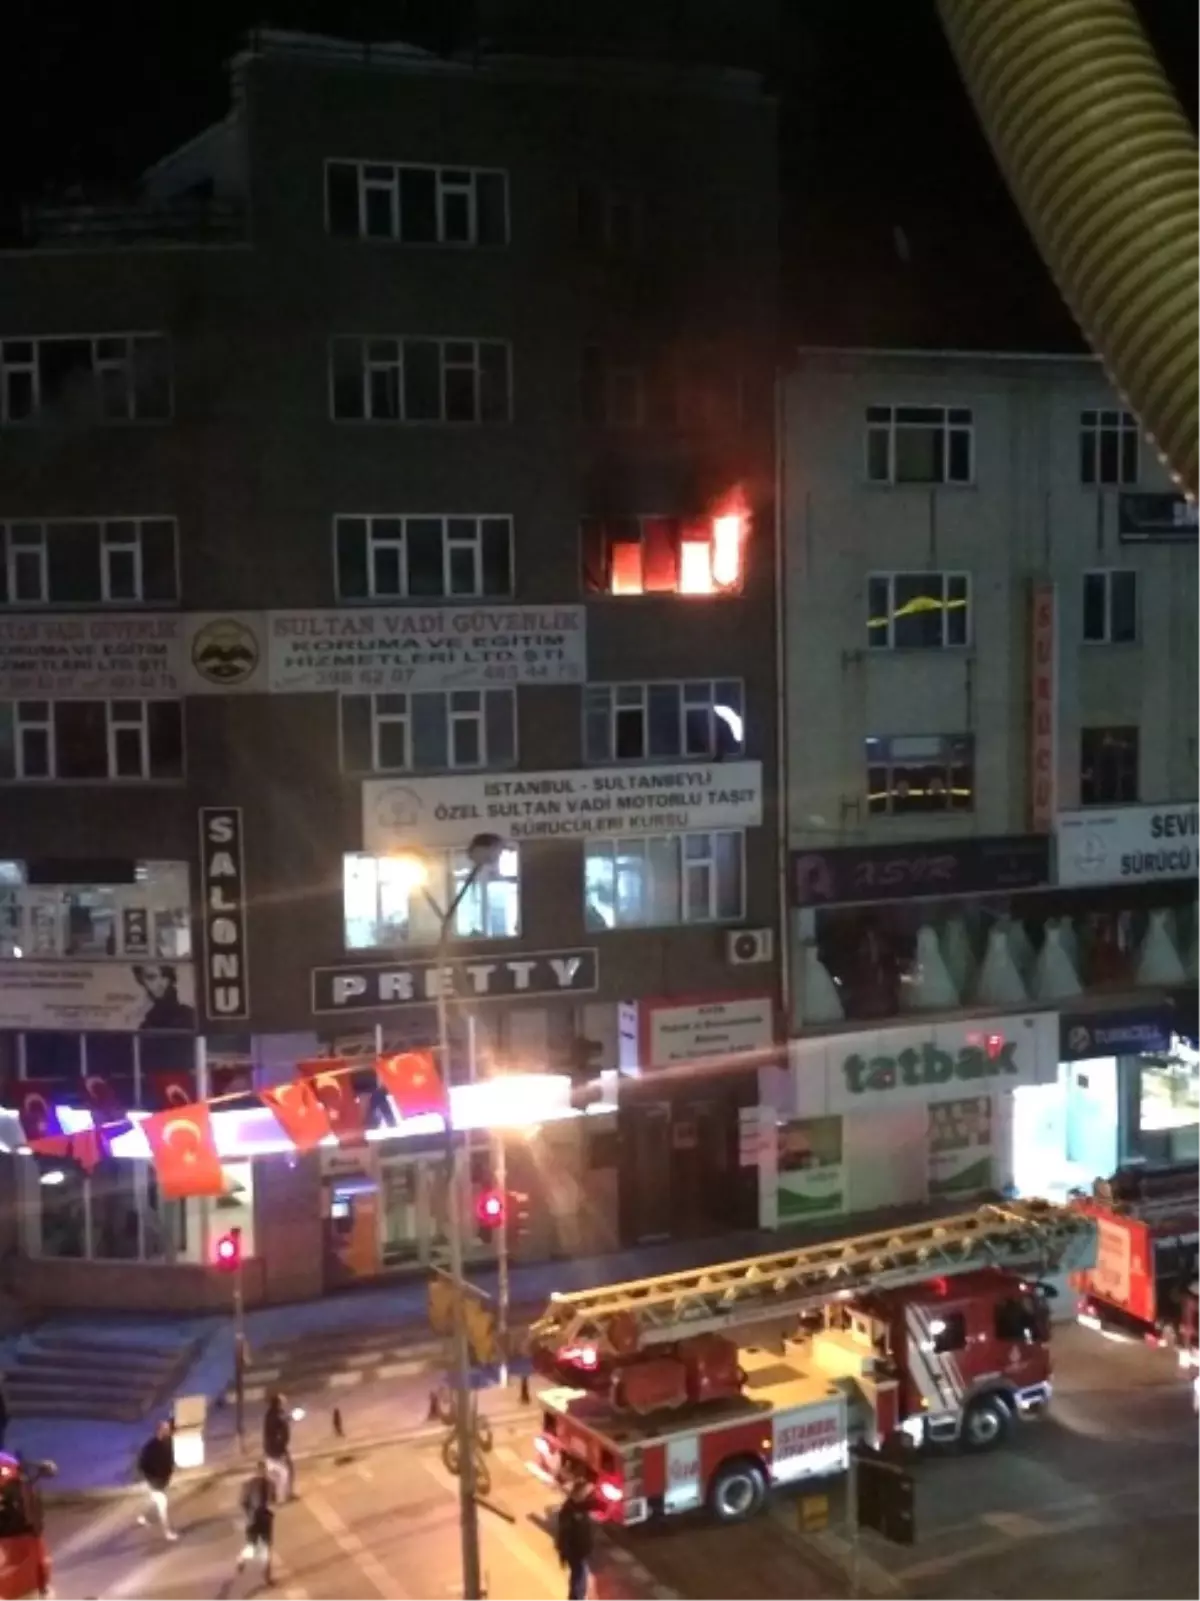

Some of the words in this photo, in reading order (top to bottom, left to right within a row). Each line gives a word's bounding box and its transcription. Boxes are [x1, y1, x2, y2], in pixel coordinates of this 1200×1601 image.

[273, 615, 374, 637] SULTAN
[383, 610, 444, 635] VADİ
[452, 609, 579, 634] GÜVENLİK
[291, 637, 421, 652] KORUMA
[434, 803, 483, 822] ÖZEL
[486, 800, 561, 819] SULTAN
[566, 794, 611, 813] VADİ
[616, 791, 703, 810] MOTORLU
[629, 811, 689, 830] KURSU
[1120, 845, 1192, 876] SÜRÜCÜ
[208, 816, 241, 1013] SALONU
[332, 957, 582, 1005] PRETTY
[842, 1041, 1018, 1094] tatbak
